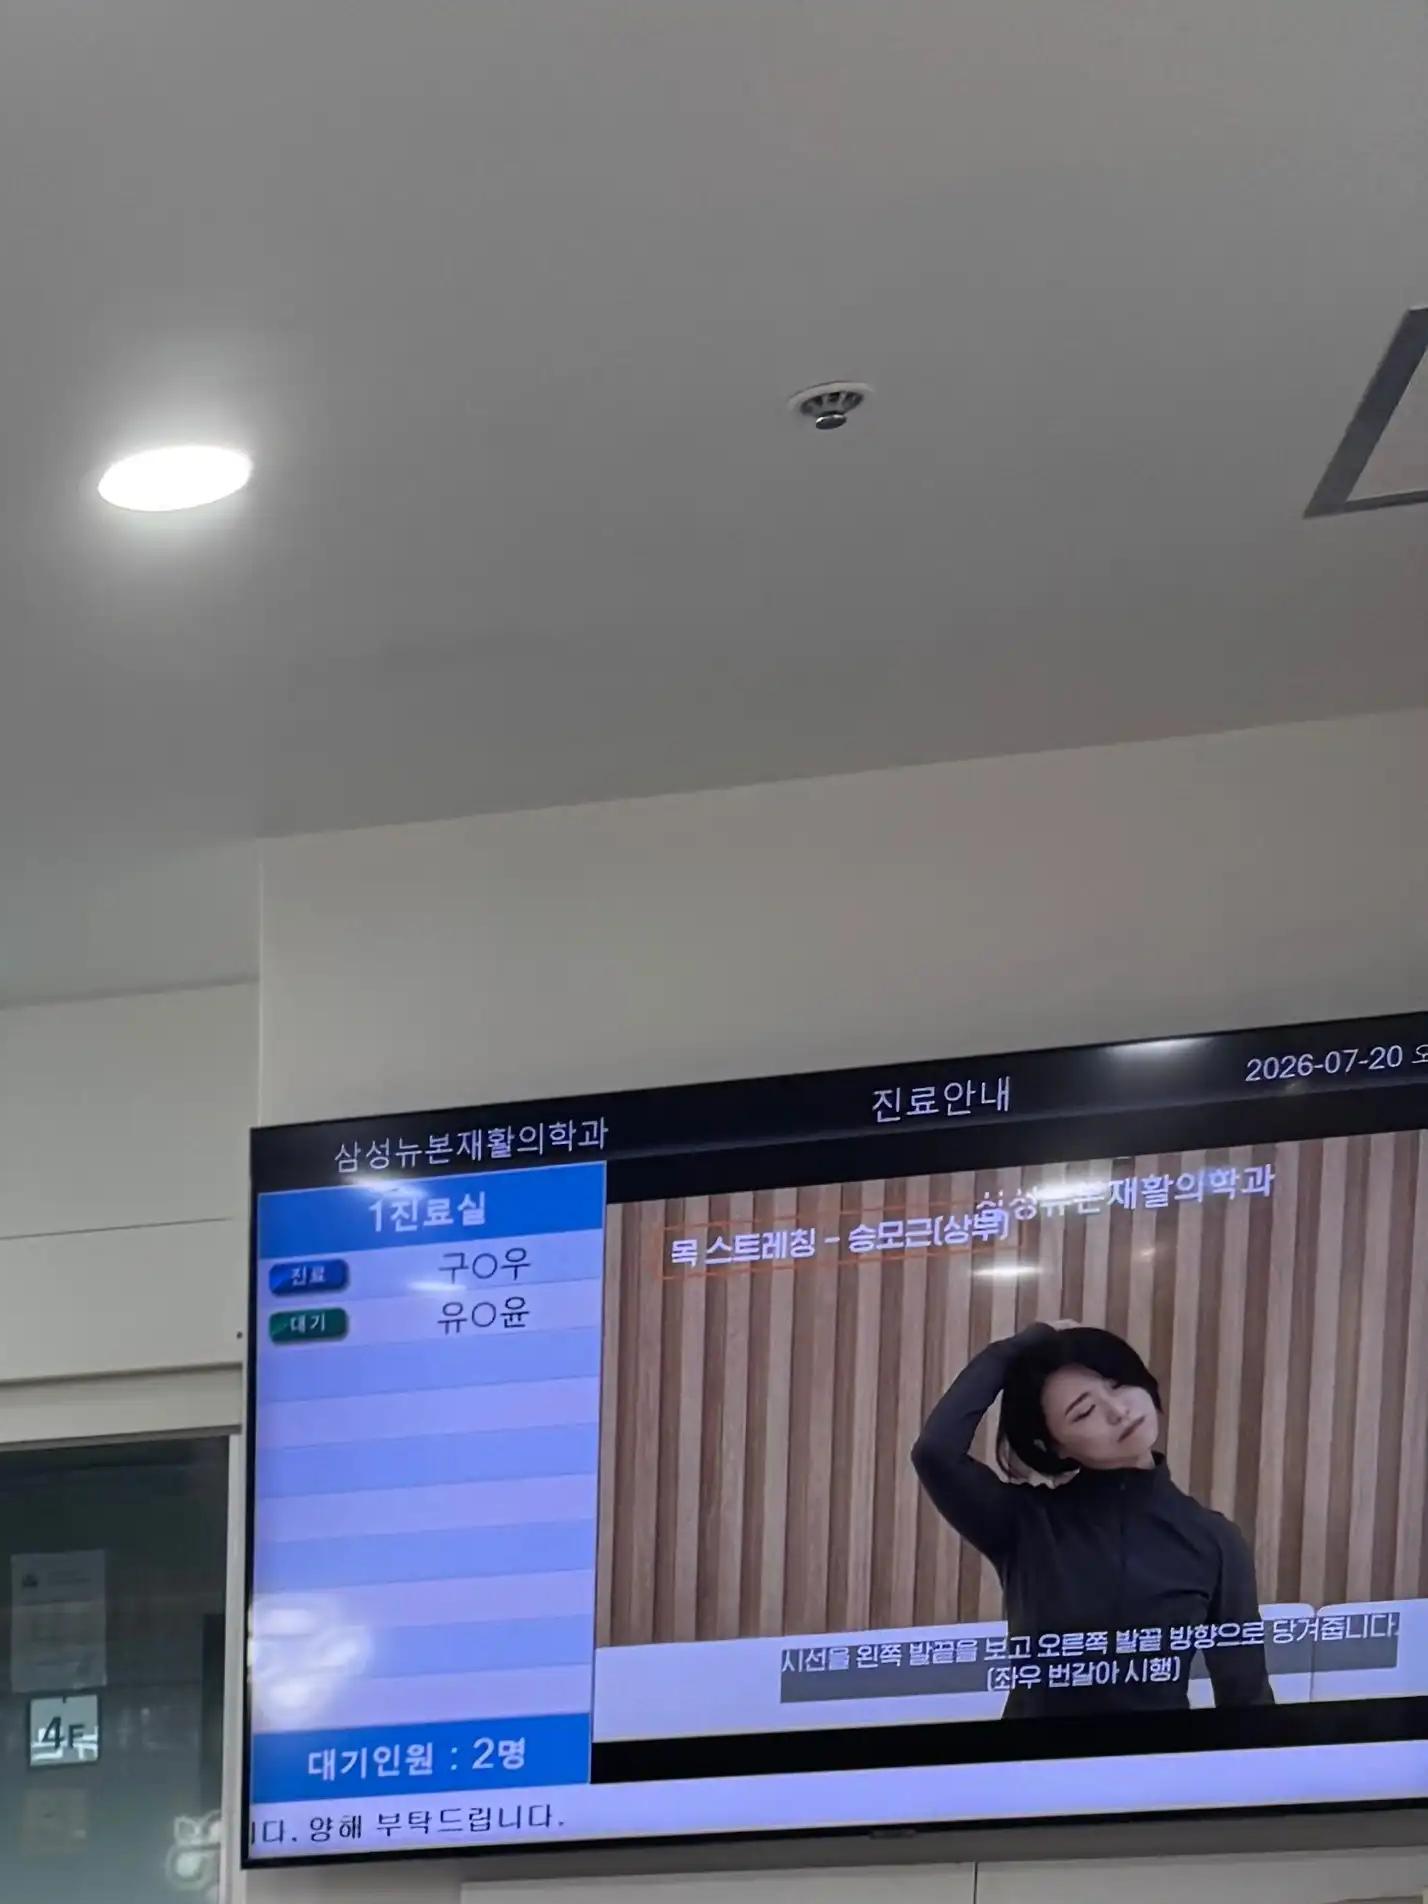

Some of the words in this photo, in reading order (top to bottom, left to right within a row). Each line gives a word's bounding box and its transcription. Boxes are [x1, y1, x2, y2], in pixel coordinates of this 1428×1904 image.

[1245, 1044, 1403, 1084] 2026-07-20
[871, 1075, 1012, 1123] 진료안내
[334, 1116, 609, 1175] 삼성뉴본재활의학과
[368, 1190, 487, 1233] 1진료실
[671, 1238, 698, 1267] 목
[705, 1226, 816, 1266] 스트레칭
[290, 1265, 327, 1286] 진료
[289, 1313, 327, 1333] 대기
[781, 1647, 850, 1674] 시선을
[856, 1642, 902, 1669] 왼쪽
[908, 1638, 978, 1667] 발끝을
[984, 1636, 1032, 1662] 보고
[1037, 1630, 1108, 1660] 오른쪽
[1115, 1627, 1163, 1655] 발끝
[1169, 1621, 1265, 1651] 방향으로
[986, 1664, 1043, 1693] (좌우
[1047, 1660, 1120, 1689] 번갈아
[1123, 1657, 1181, 1685] 시행)
[307, 1742, 435, 1782] 대기인원
[471, 1736, 527, 1770] 2명
[309, 1814, 364, 1844] 양해
[375, 1802, 566, 1839] 부탁드립니다.
